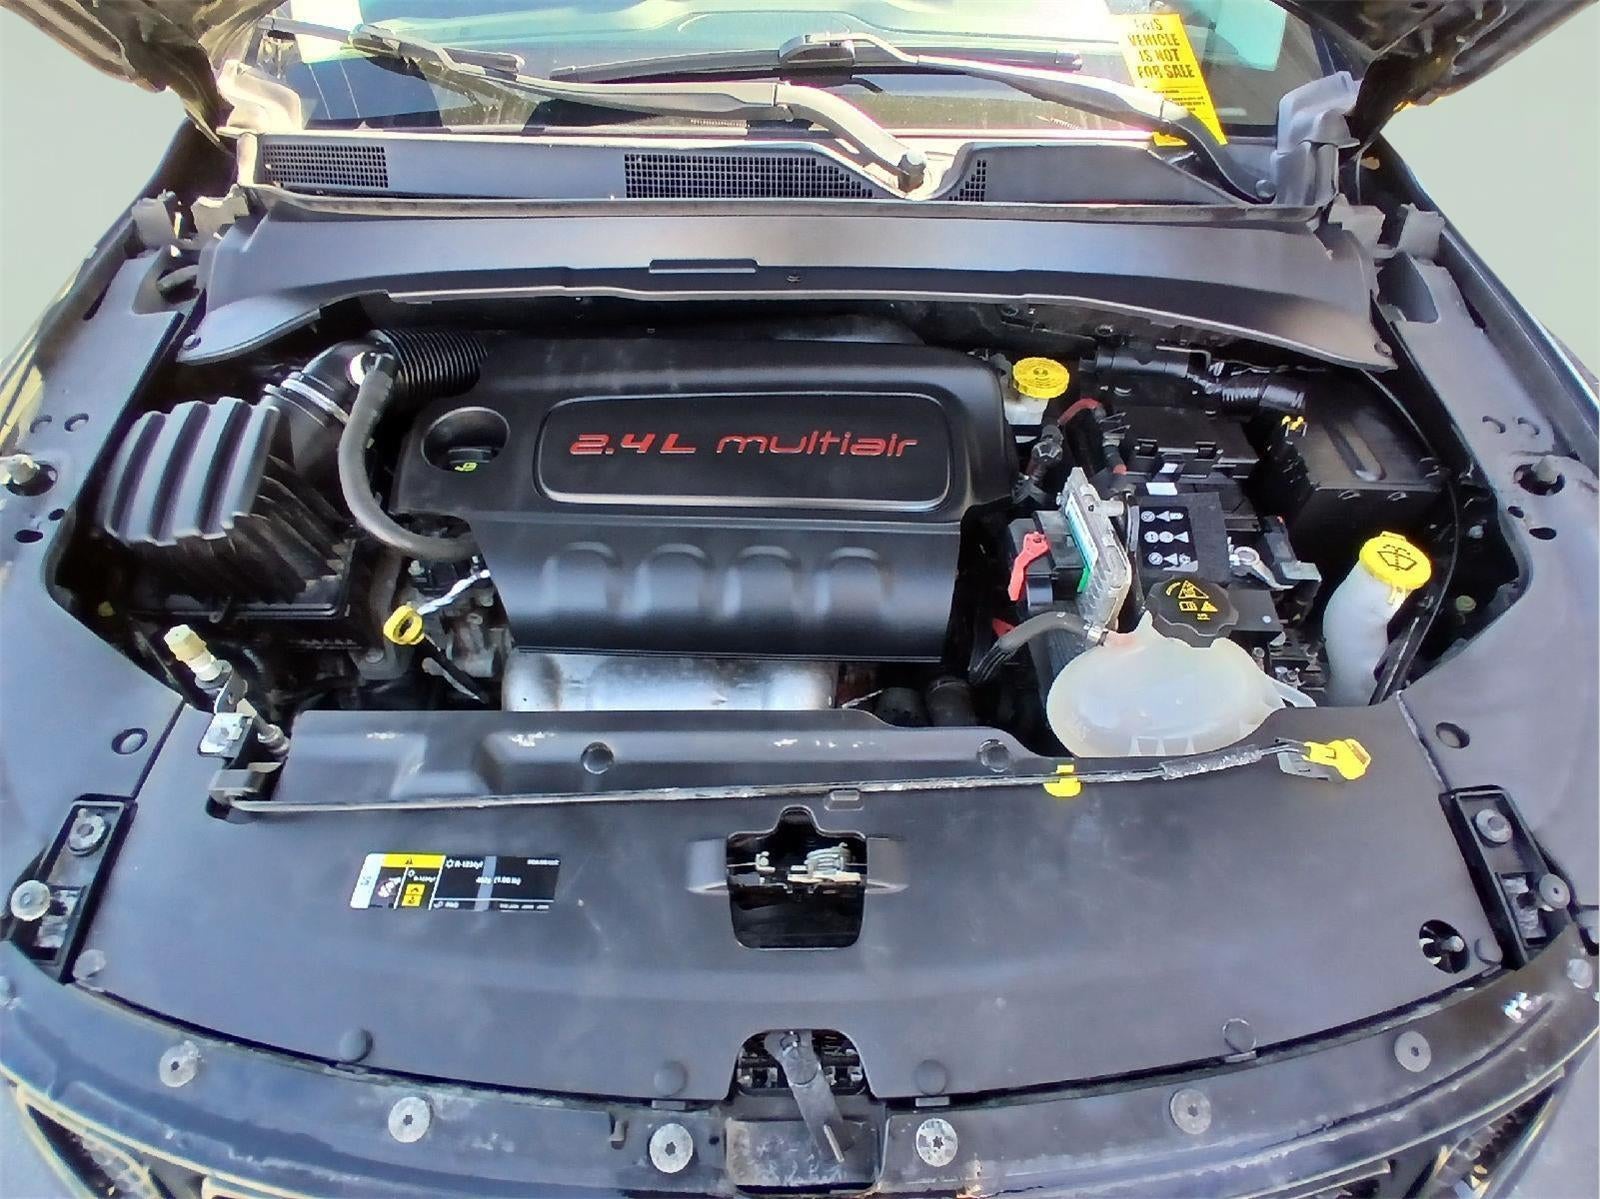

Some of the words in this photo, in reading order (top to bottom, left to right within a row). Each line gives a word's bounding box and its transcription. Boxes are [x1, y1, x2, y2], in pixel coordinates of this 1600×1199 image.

[1127, 33, 1181, 47] VEHICLE
[1139, 49, 1154, 62] IS
[1155, 48, 1181, 62] NOT
[1137, 66, 1164, 79] FOR
[1164, 64, 1196, 79] SALE
[716, 430, 918, 457] multiair
